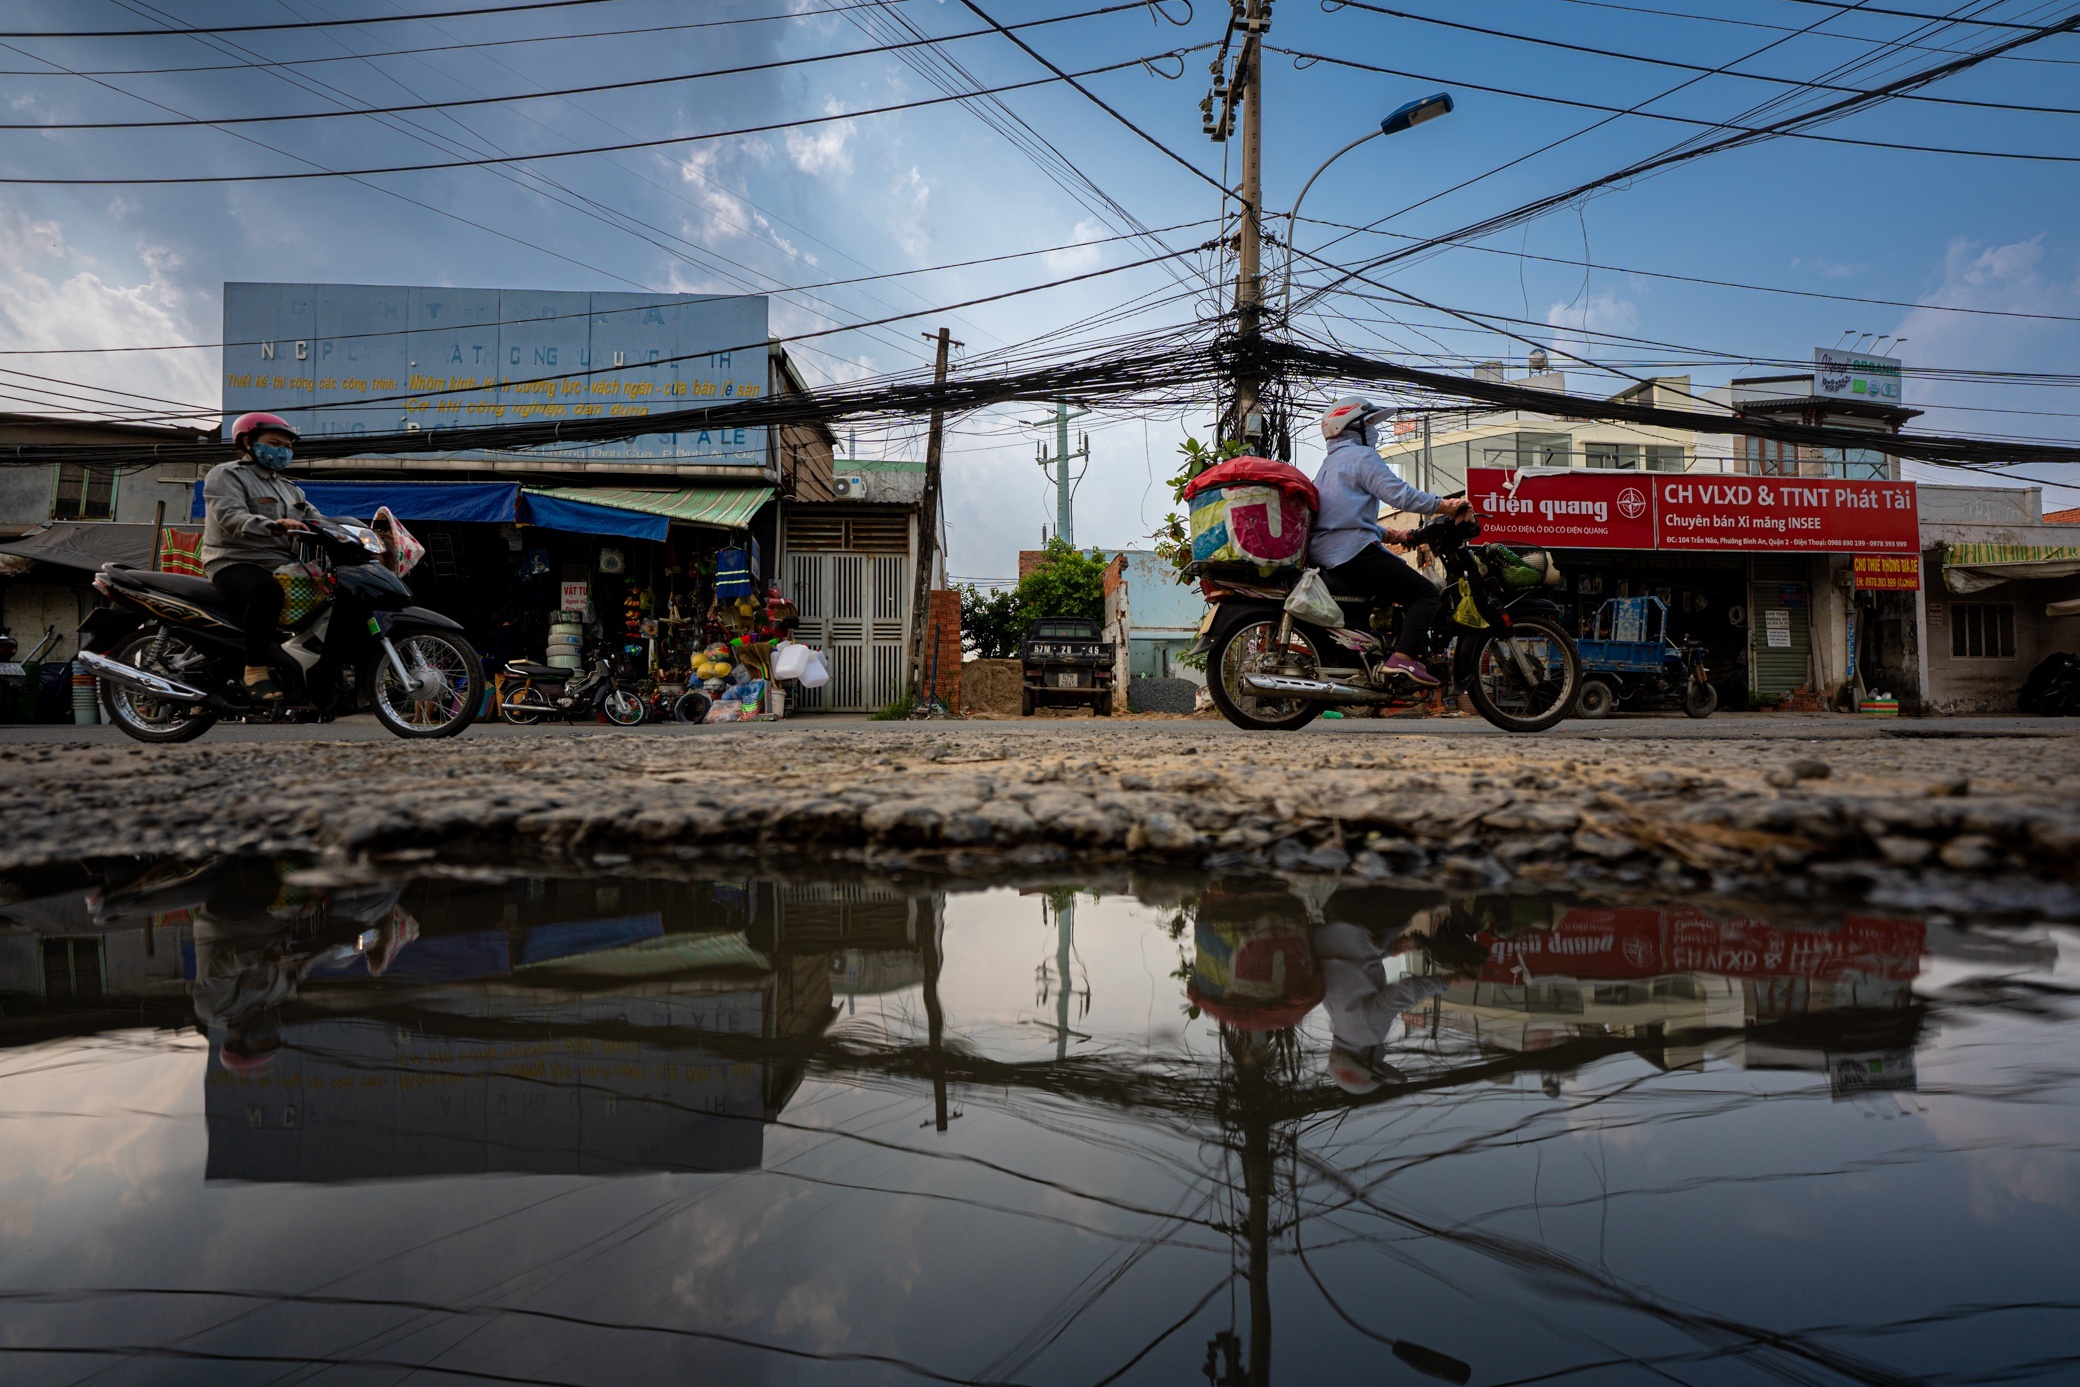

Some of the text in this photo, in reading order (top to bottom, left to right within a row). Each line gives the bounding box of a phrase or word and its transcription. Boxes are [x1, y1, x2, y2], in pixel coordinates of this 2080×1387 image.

[227, 373, 252, 389] Thiết
[289, 376, 315, 393] công
[318, 376, 337, 390] các
[341, 377, 367, 393] công
[408, 373, 446, 391] Nhôm
[591, 378, 620, 395] vách
[622, 379, 653, 399] ngăn
[436, 400, 461, 413] khí
[466, 400, 506, 416] công
[1664, 484, 1911, 509] CH VLXD & TTNT Phát Tài
[1540, 500, 1608, 522] quang
[1507, 524, 1517, 533] CÓ
[1566, 525, 1582, 535] ĐIỆN
[1583, 527, 1609, 535] QUANG
[1665, 514, 1821, 532] Chuyên bán Xi măng INSEE
[1678, 536, 1690, 544] 104
[1842, 539, 1853, 547] 890
[1895, 540, 1907, 548] 999
[1034, 645, 1100, 655] 57M 28 45
